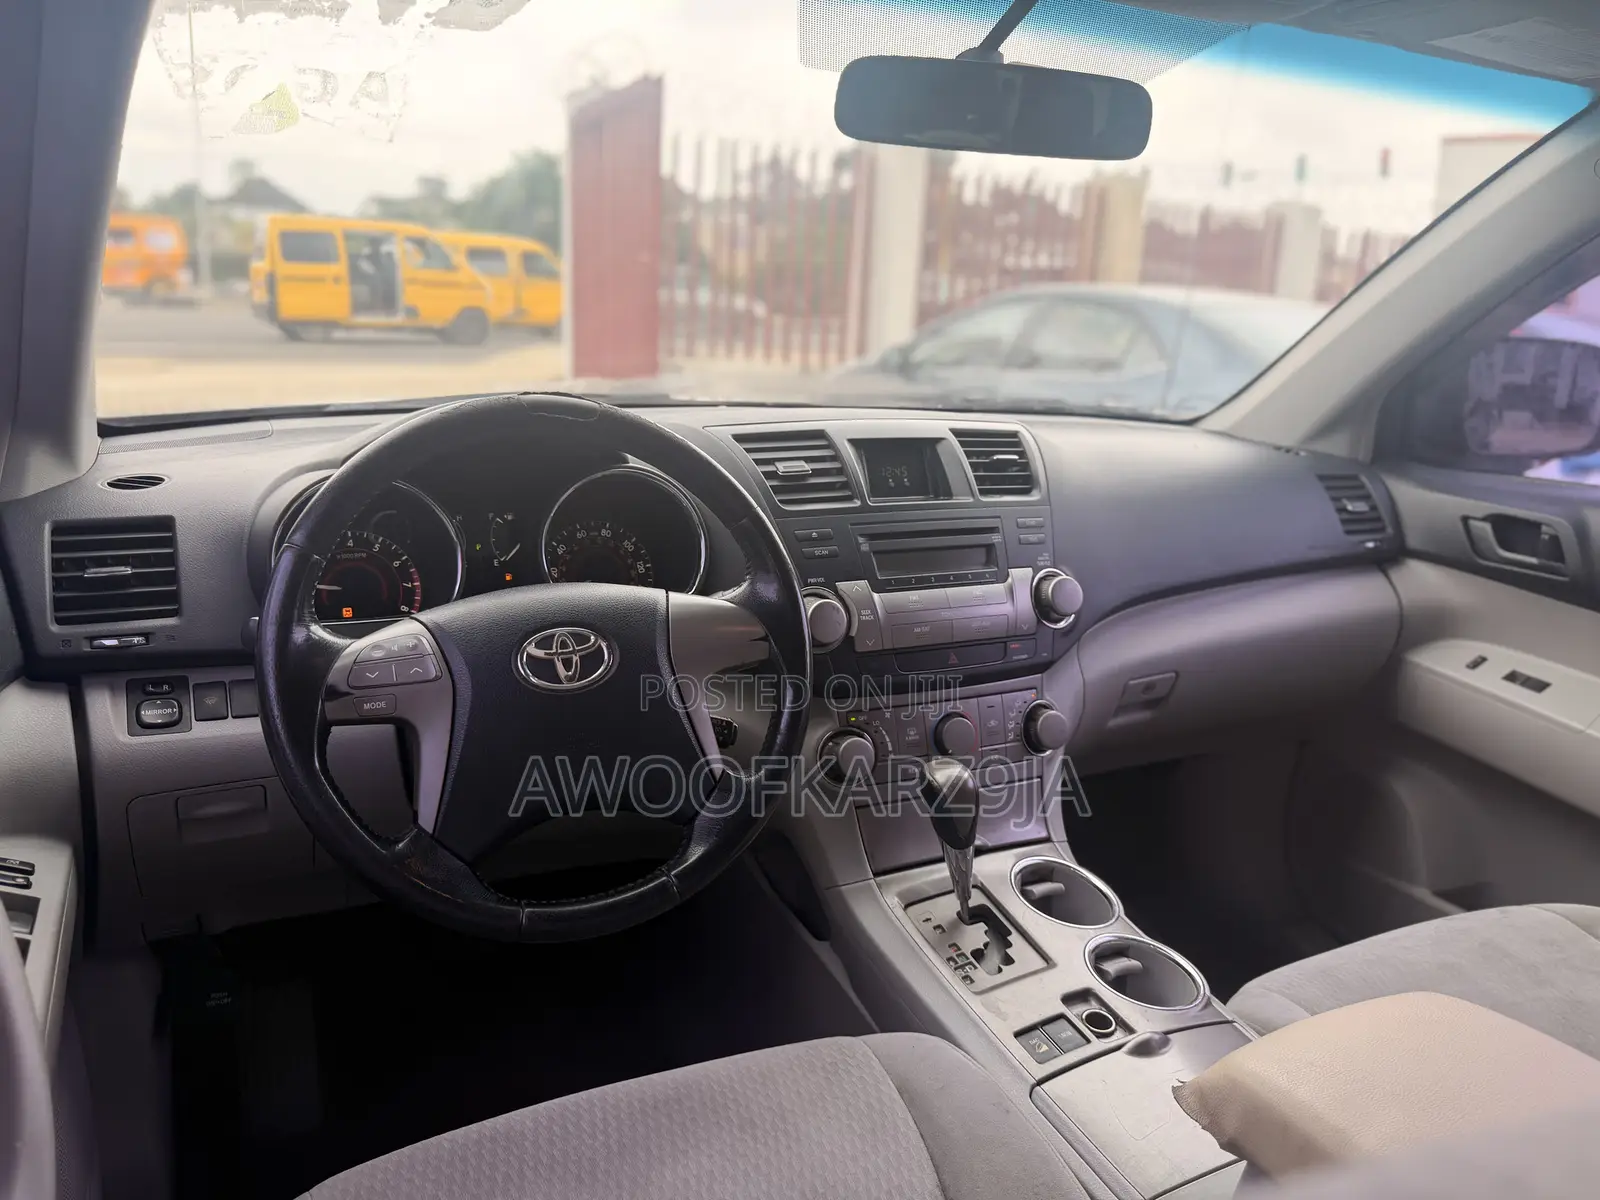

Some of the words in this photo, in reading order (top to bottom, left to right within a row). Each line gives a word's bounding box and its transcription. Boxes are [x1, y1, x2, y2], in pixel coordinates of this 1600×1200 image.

[576, 530, 587, 539] 60
[600, 528, 612, 537] 80
[372, 544, 381, 552] 5
[556, 544, 567, 555] 40
[622, 540, 635, 552] 100
[392, 560, 401, 568] 6
[494, 559, 500, 567] E
[636, 561, 646, 574] 120
[550, 567, 558, 578] 20
[363, 701, 387, 710] MODE
